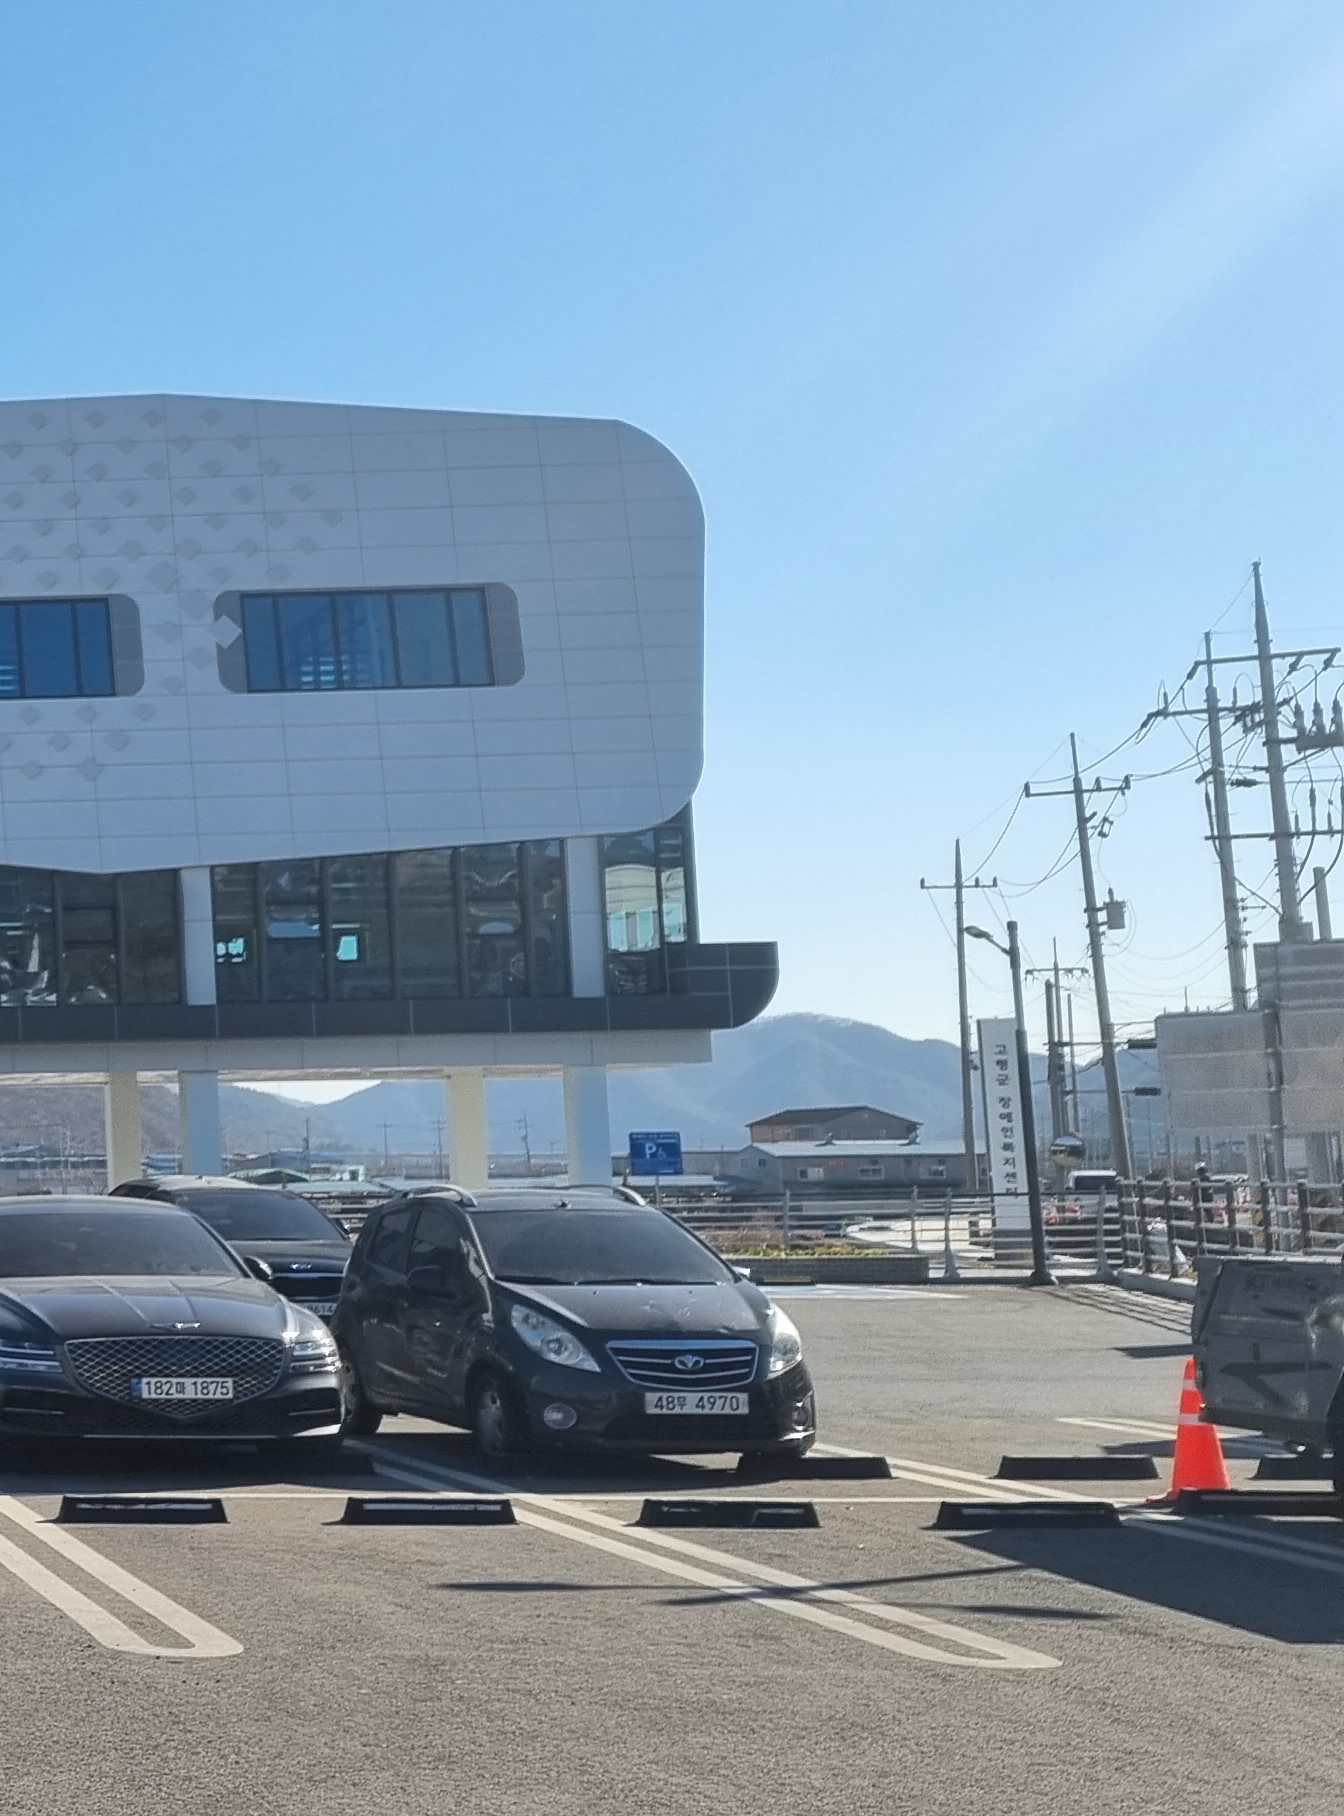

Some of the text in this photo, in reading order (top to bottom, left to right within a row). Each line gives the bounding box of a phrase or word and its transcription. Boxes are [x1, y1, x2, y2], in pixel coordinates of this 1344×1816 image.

[994, 1044, 1011, 1086] 고령군
[645, 1143, 657, 1160] P
[144, 1380, 230, 1396] 182마 1875
[695, 1395, 740, 1411] 4970
